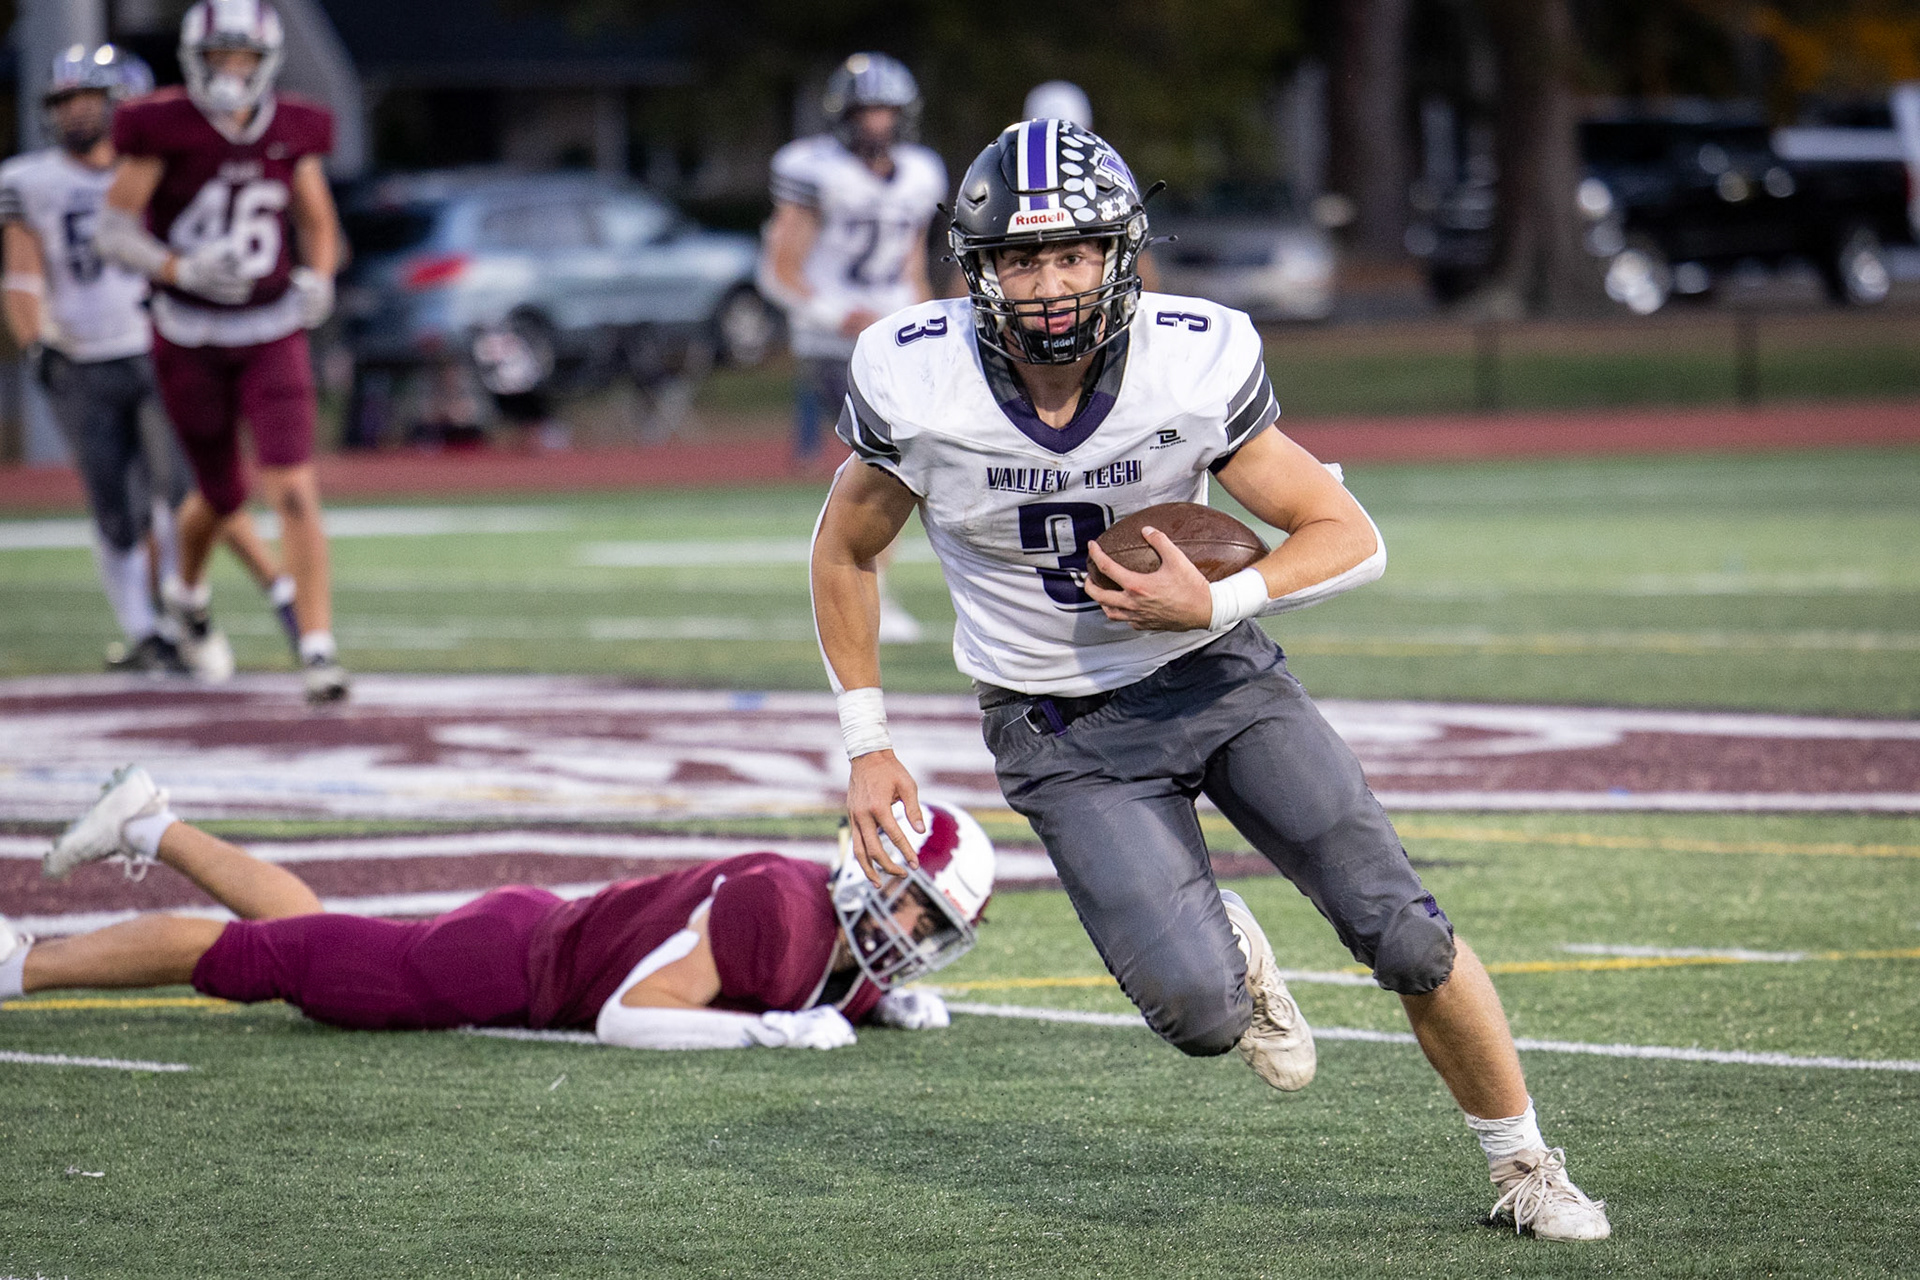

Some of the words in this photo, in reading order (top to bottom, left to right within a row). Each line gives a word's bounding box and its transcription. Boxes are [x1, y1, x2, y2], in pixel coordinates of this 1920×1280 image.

[168, 178, 289, 280] 46
[1016, 211, 1065, 226] Riddell
[895, 315, 948, 347] 3
[1156, 310, 1212, 333] 3
[986, 467, 1071, 495] VALLEY
[1083, 459, 1142, 490] TECH
[1017, 501, 1116, 613] 3
